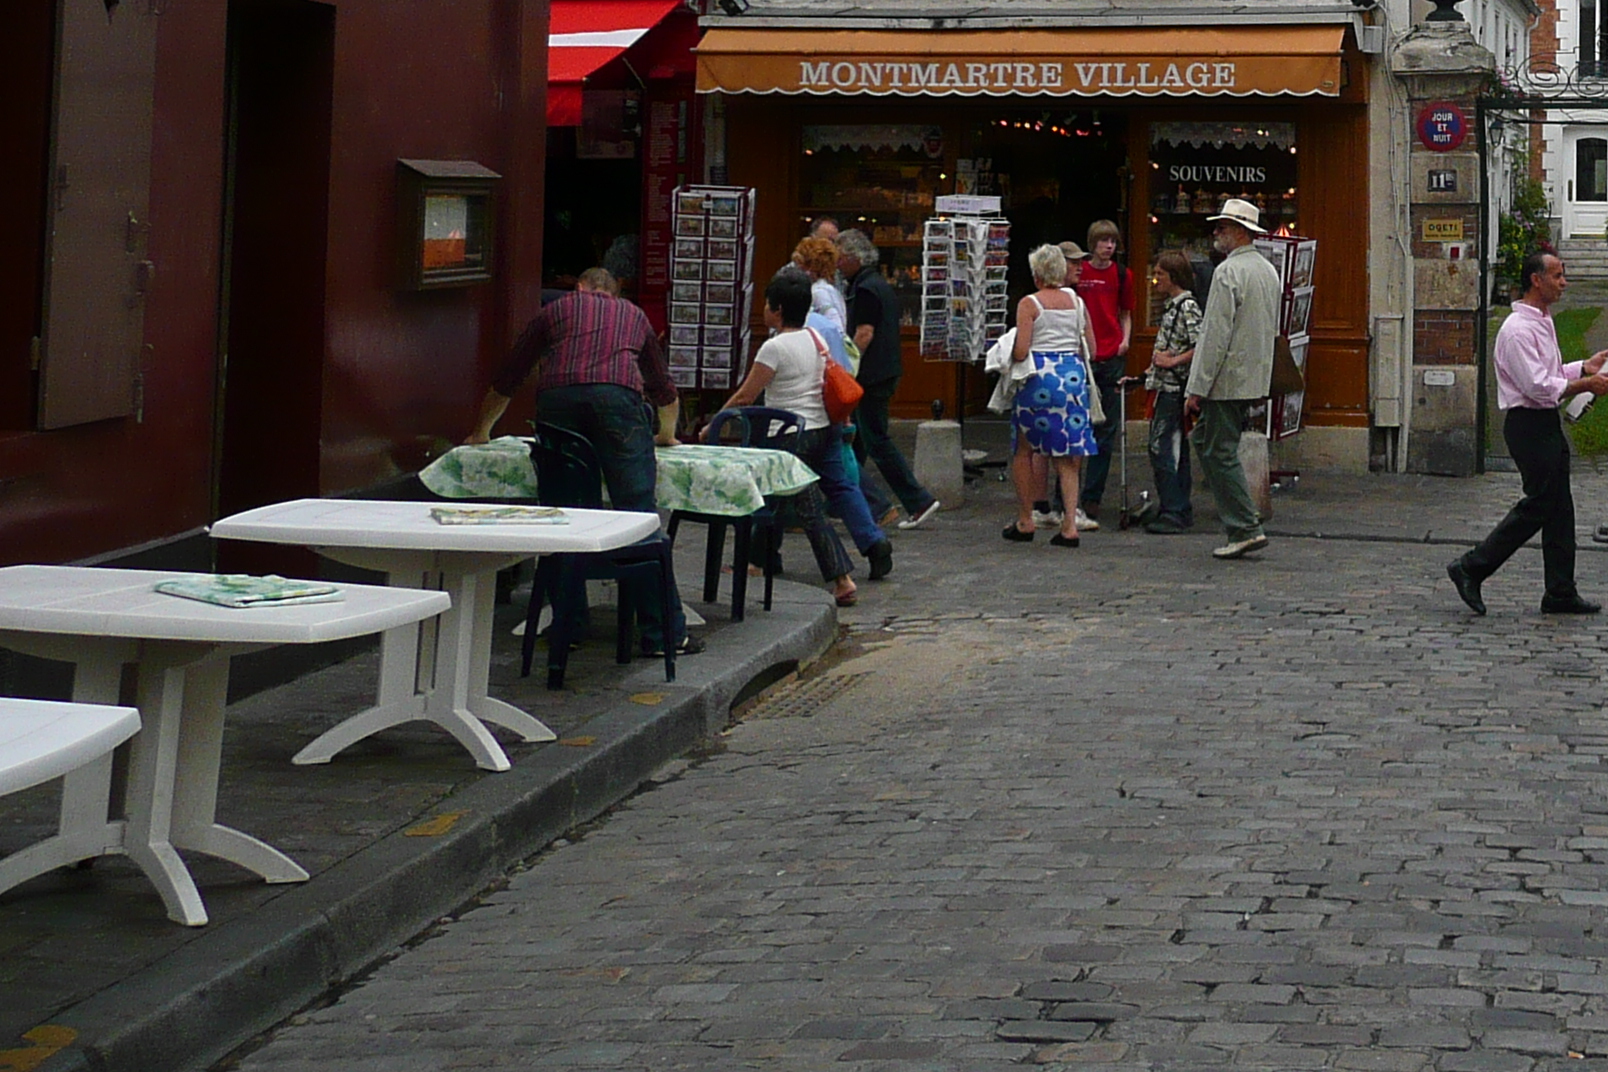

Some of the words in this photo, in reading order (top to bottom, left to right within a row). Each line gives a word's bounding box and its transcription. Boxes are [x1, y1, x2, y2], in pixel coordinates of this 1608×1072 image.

[799, 61, 1063, 88] MONTMARTRE
[1074, 62, 1236, 88] VILLAGE
[1432, 112, 1453, 121] JOUR
[1437, 123, 1448, 132] ET
[1433, 134, 1452, 142] NUIT
[1169, 165, 1266, 183] SOUVENIRS
